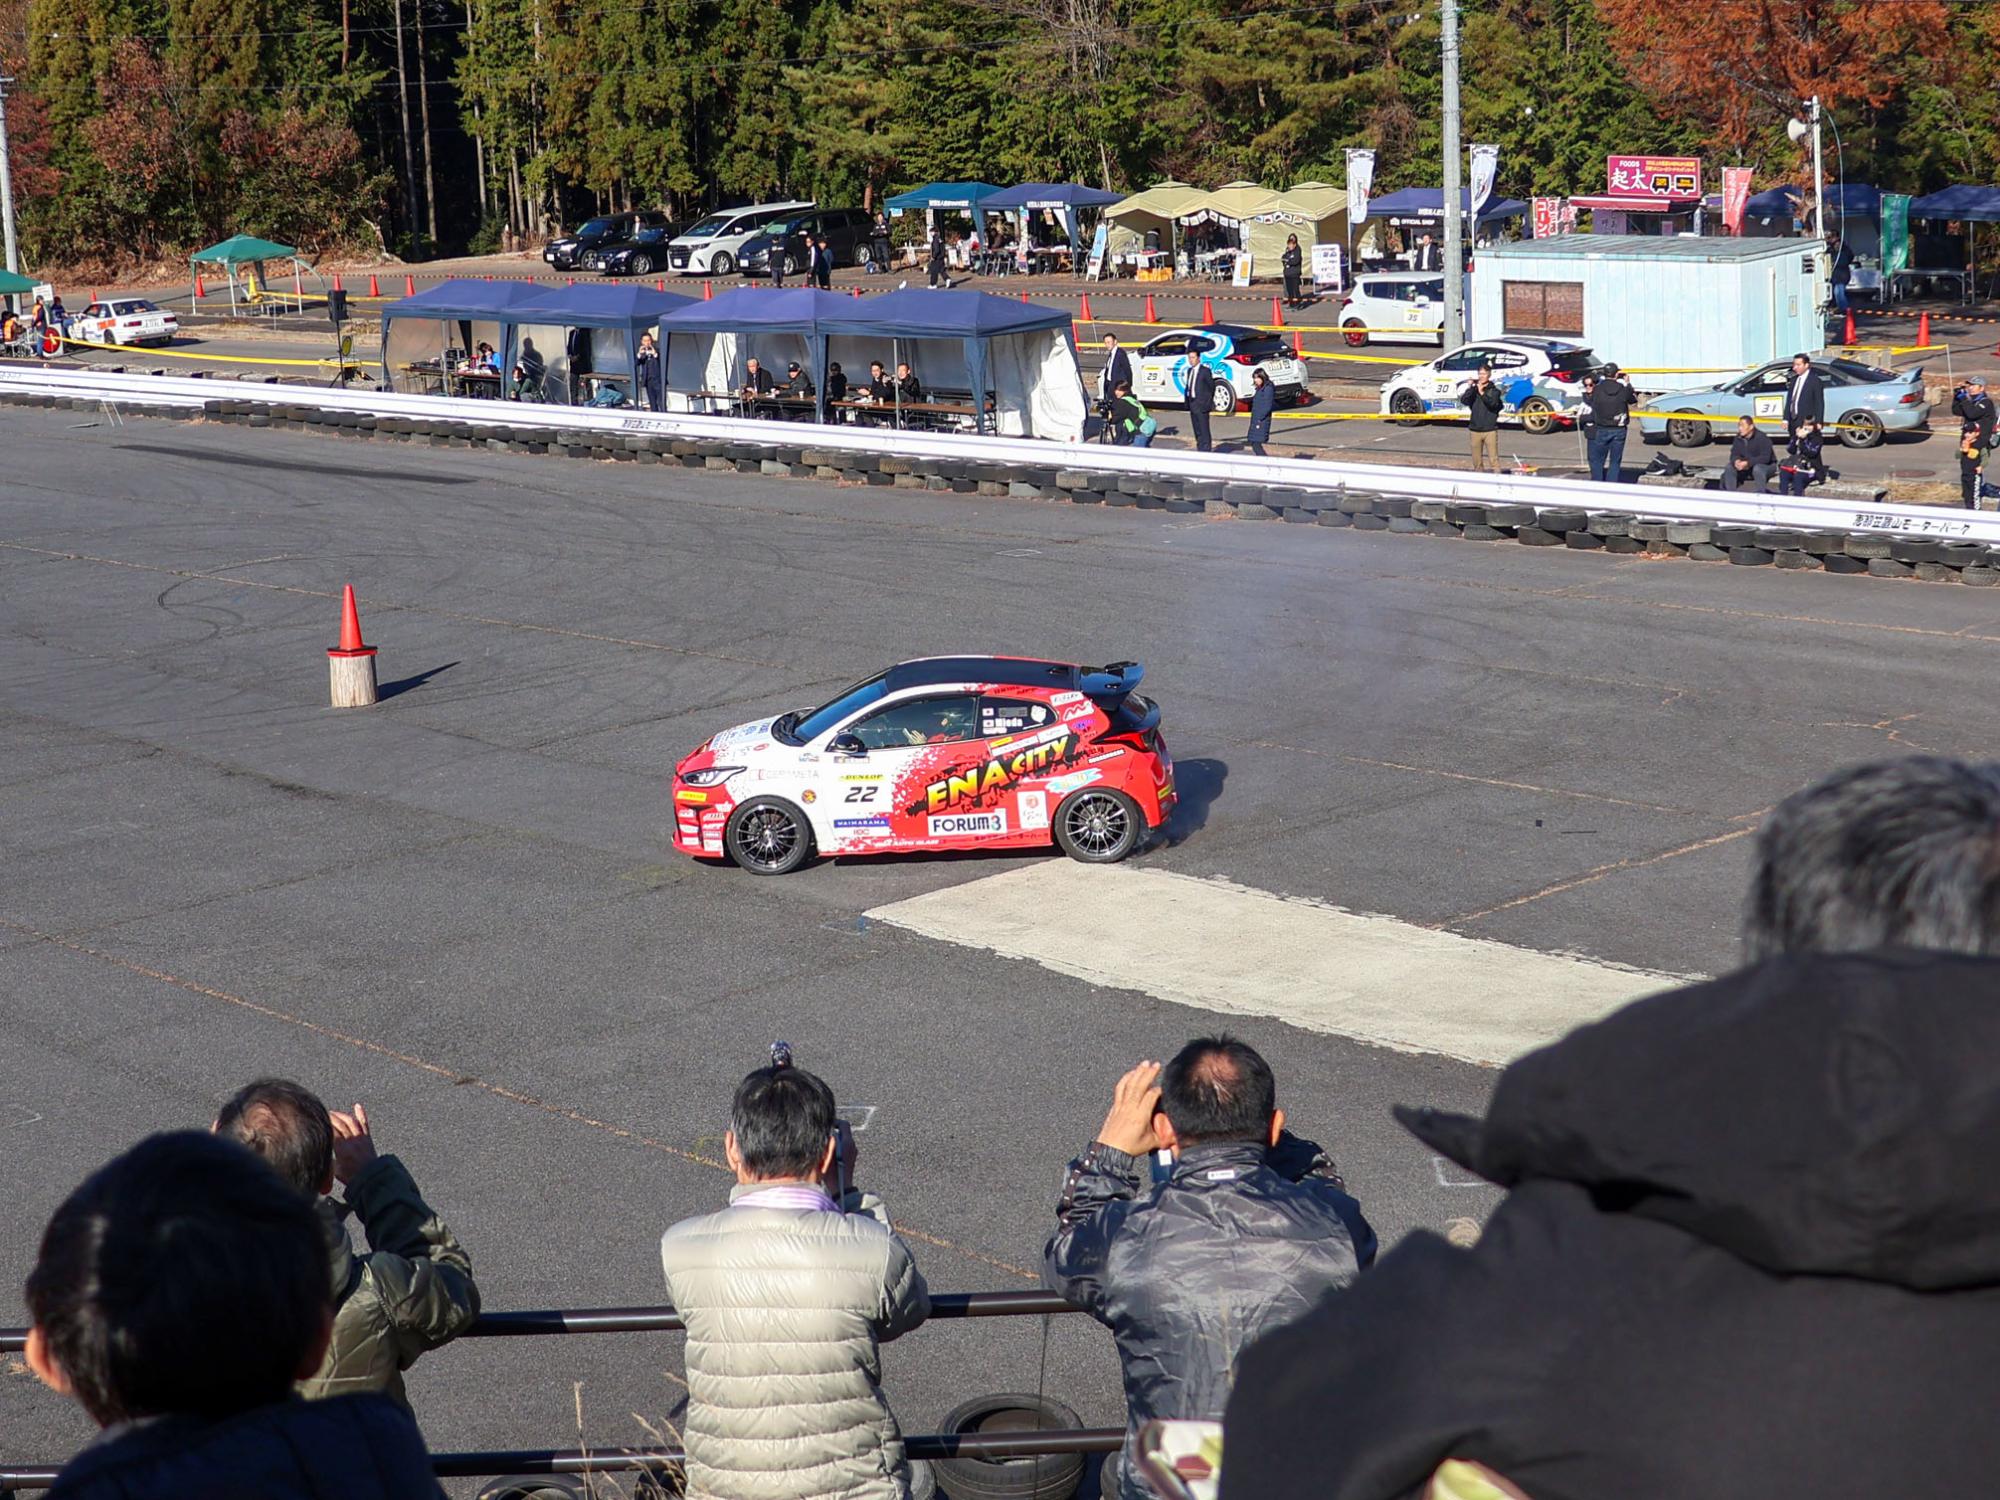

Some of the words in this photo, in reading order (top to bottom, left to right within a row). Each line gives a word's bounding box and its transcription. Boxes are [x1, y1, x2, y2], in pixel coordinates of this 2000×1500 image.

[1611, 167, 1649, 190] 起太
[1436, 385, 1449, 393] 30
[1760, 404, 1777, 413] 31
[926, 759, 1012, 815] ENA
[1010, 735, 1069, 775] CITY
[844, 786, 878, 803] 22
